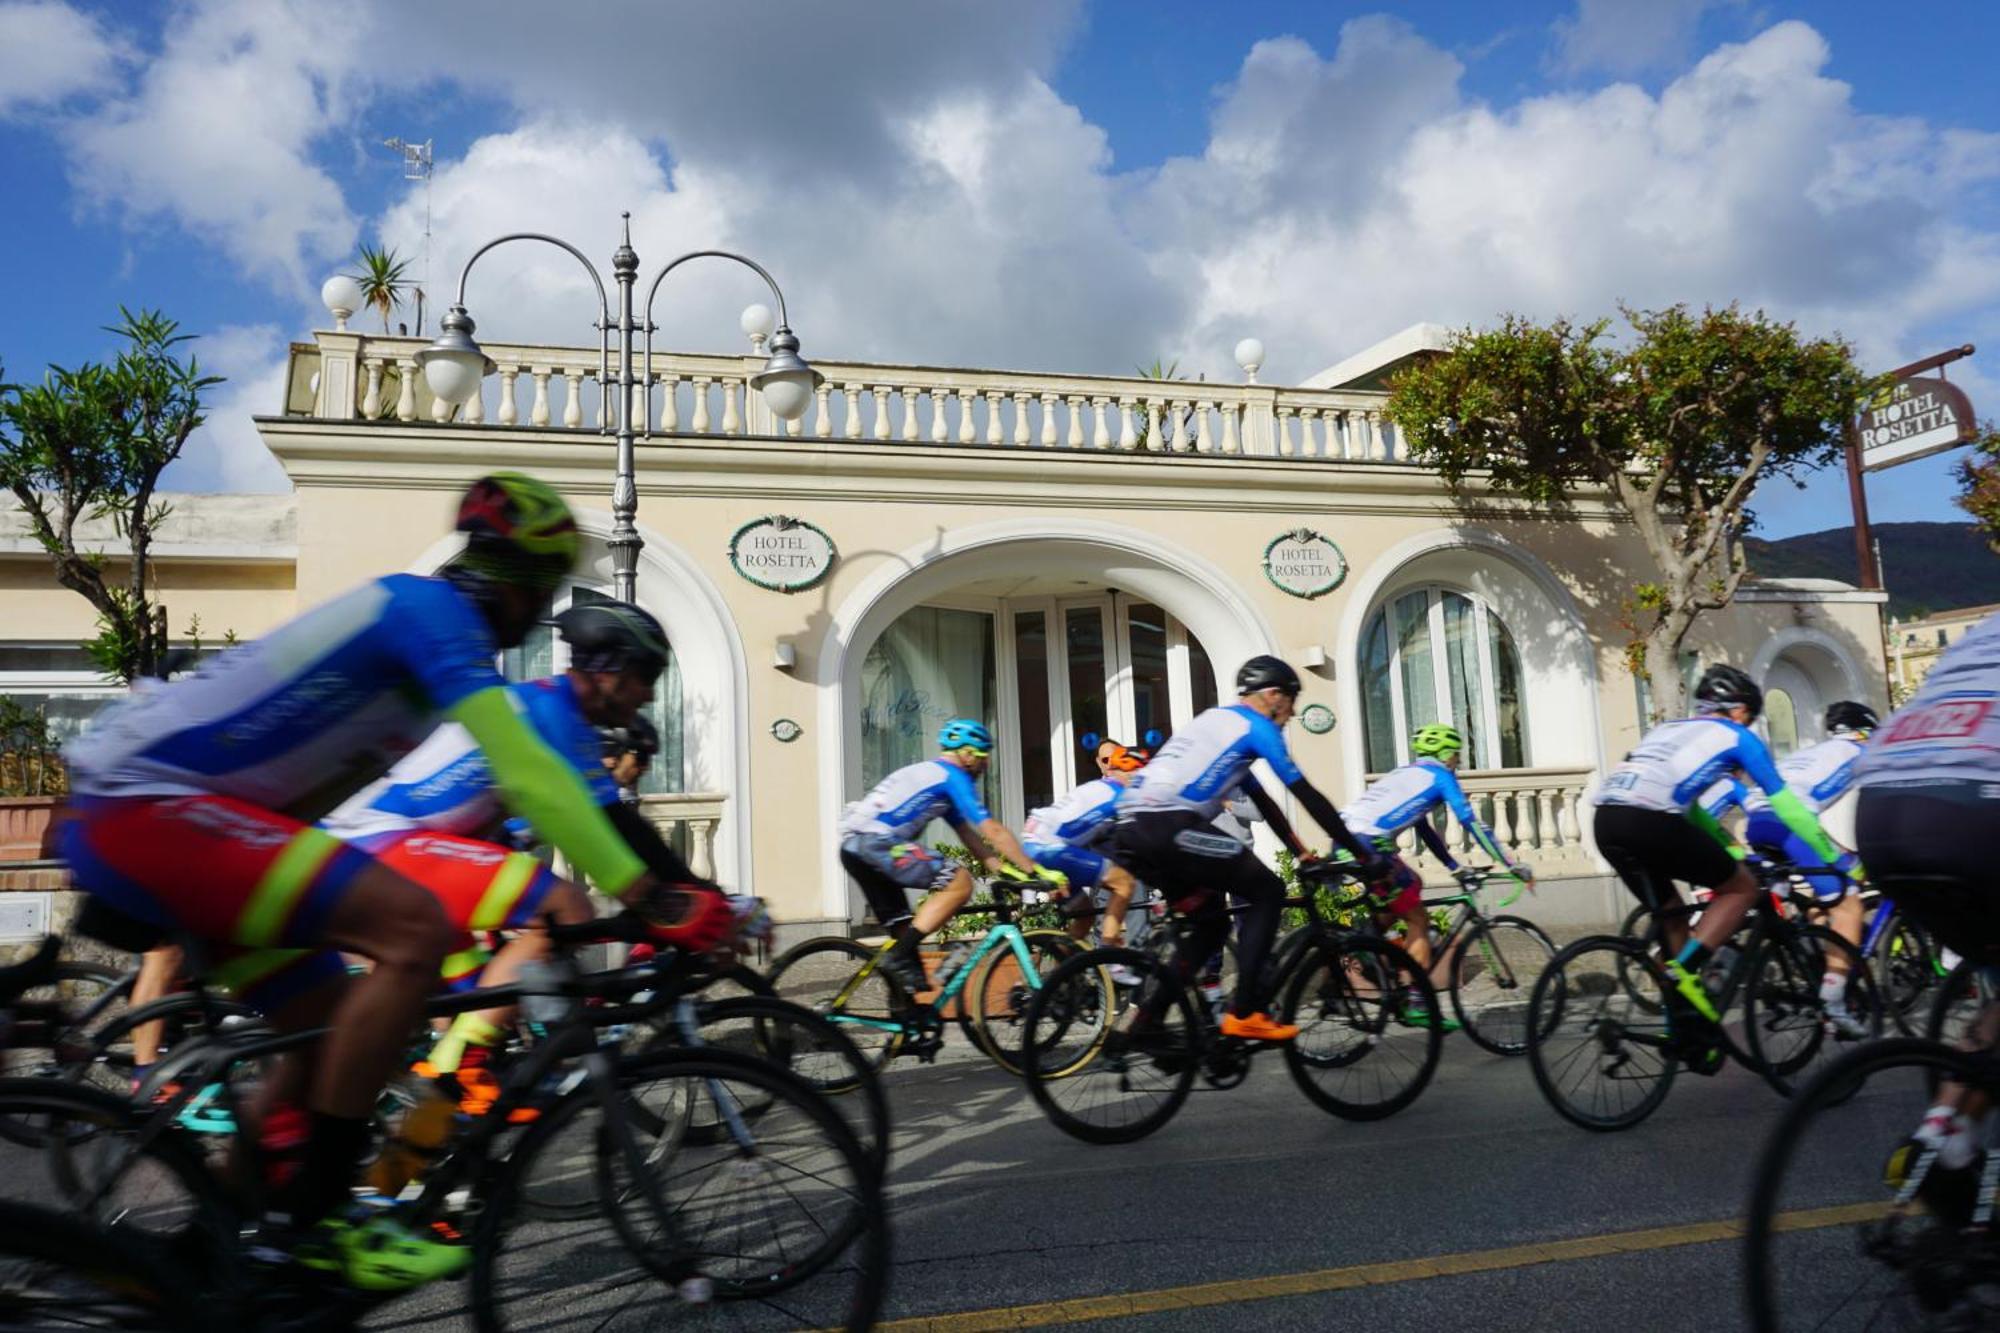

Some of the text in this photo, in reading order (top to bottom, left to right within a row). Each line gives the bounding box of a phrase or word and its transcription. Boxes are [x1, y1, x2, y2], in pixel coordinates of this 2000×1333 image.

[1872, 392, 1940, 428] HOTEL
[1861, 404, 1957, 450] ROSETTA
[755, 536, 806, 549] HOTEL
[745, 554, 816, 568] ROSETTA
[1281, 549, 1324, 561] HOTEL
[1275, 564, 1332, 577] ROSETTA
